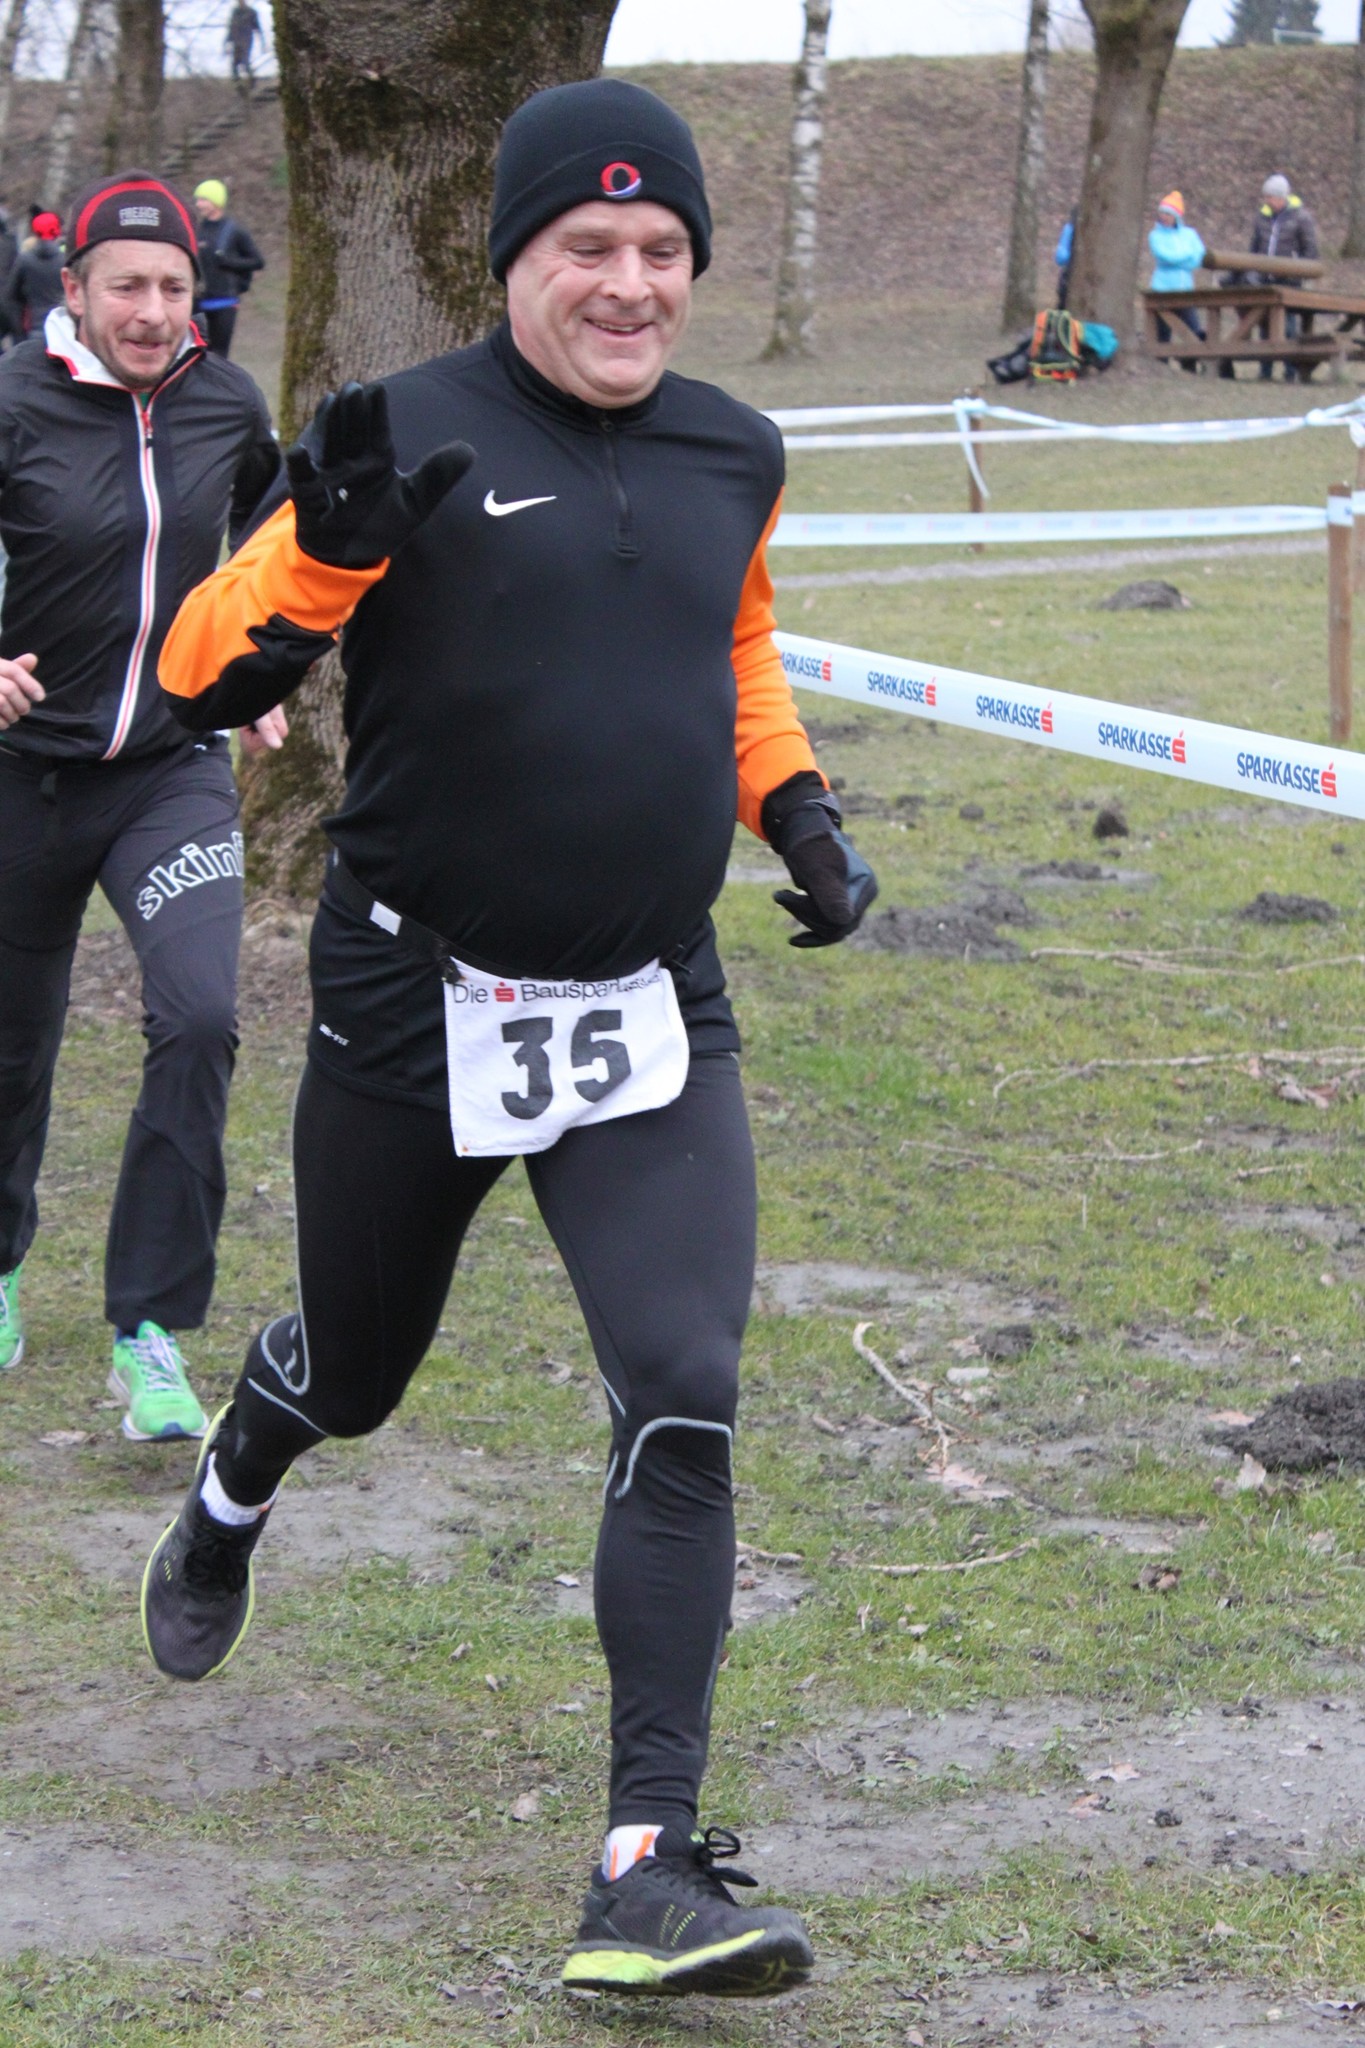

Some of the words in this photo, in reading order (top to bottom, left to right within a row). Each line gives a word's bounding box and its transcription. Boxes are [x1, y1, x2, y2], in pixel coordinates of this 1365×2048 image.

[780, 651, 822, 680] ARKASSE
[867, 670, 926, 704] SPARKASSE
[975, 695, 1041, 731] SPARKASSE
[1098, 721, 1172, 761] SPARKASSE
[1236, 751, 1322, 795] SPARKASSE
[452, 984, 489, 1004] Die
[501, 1009, 632, 1121] 35
